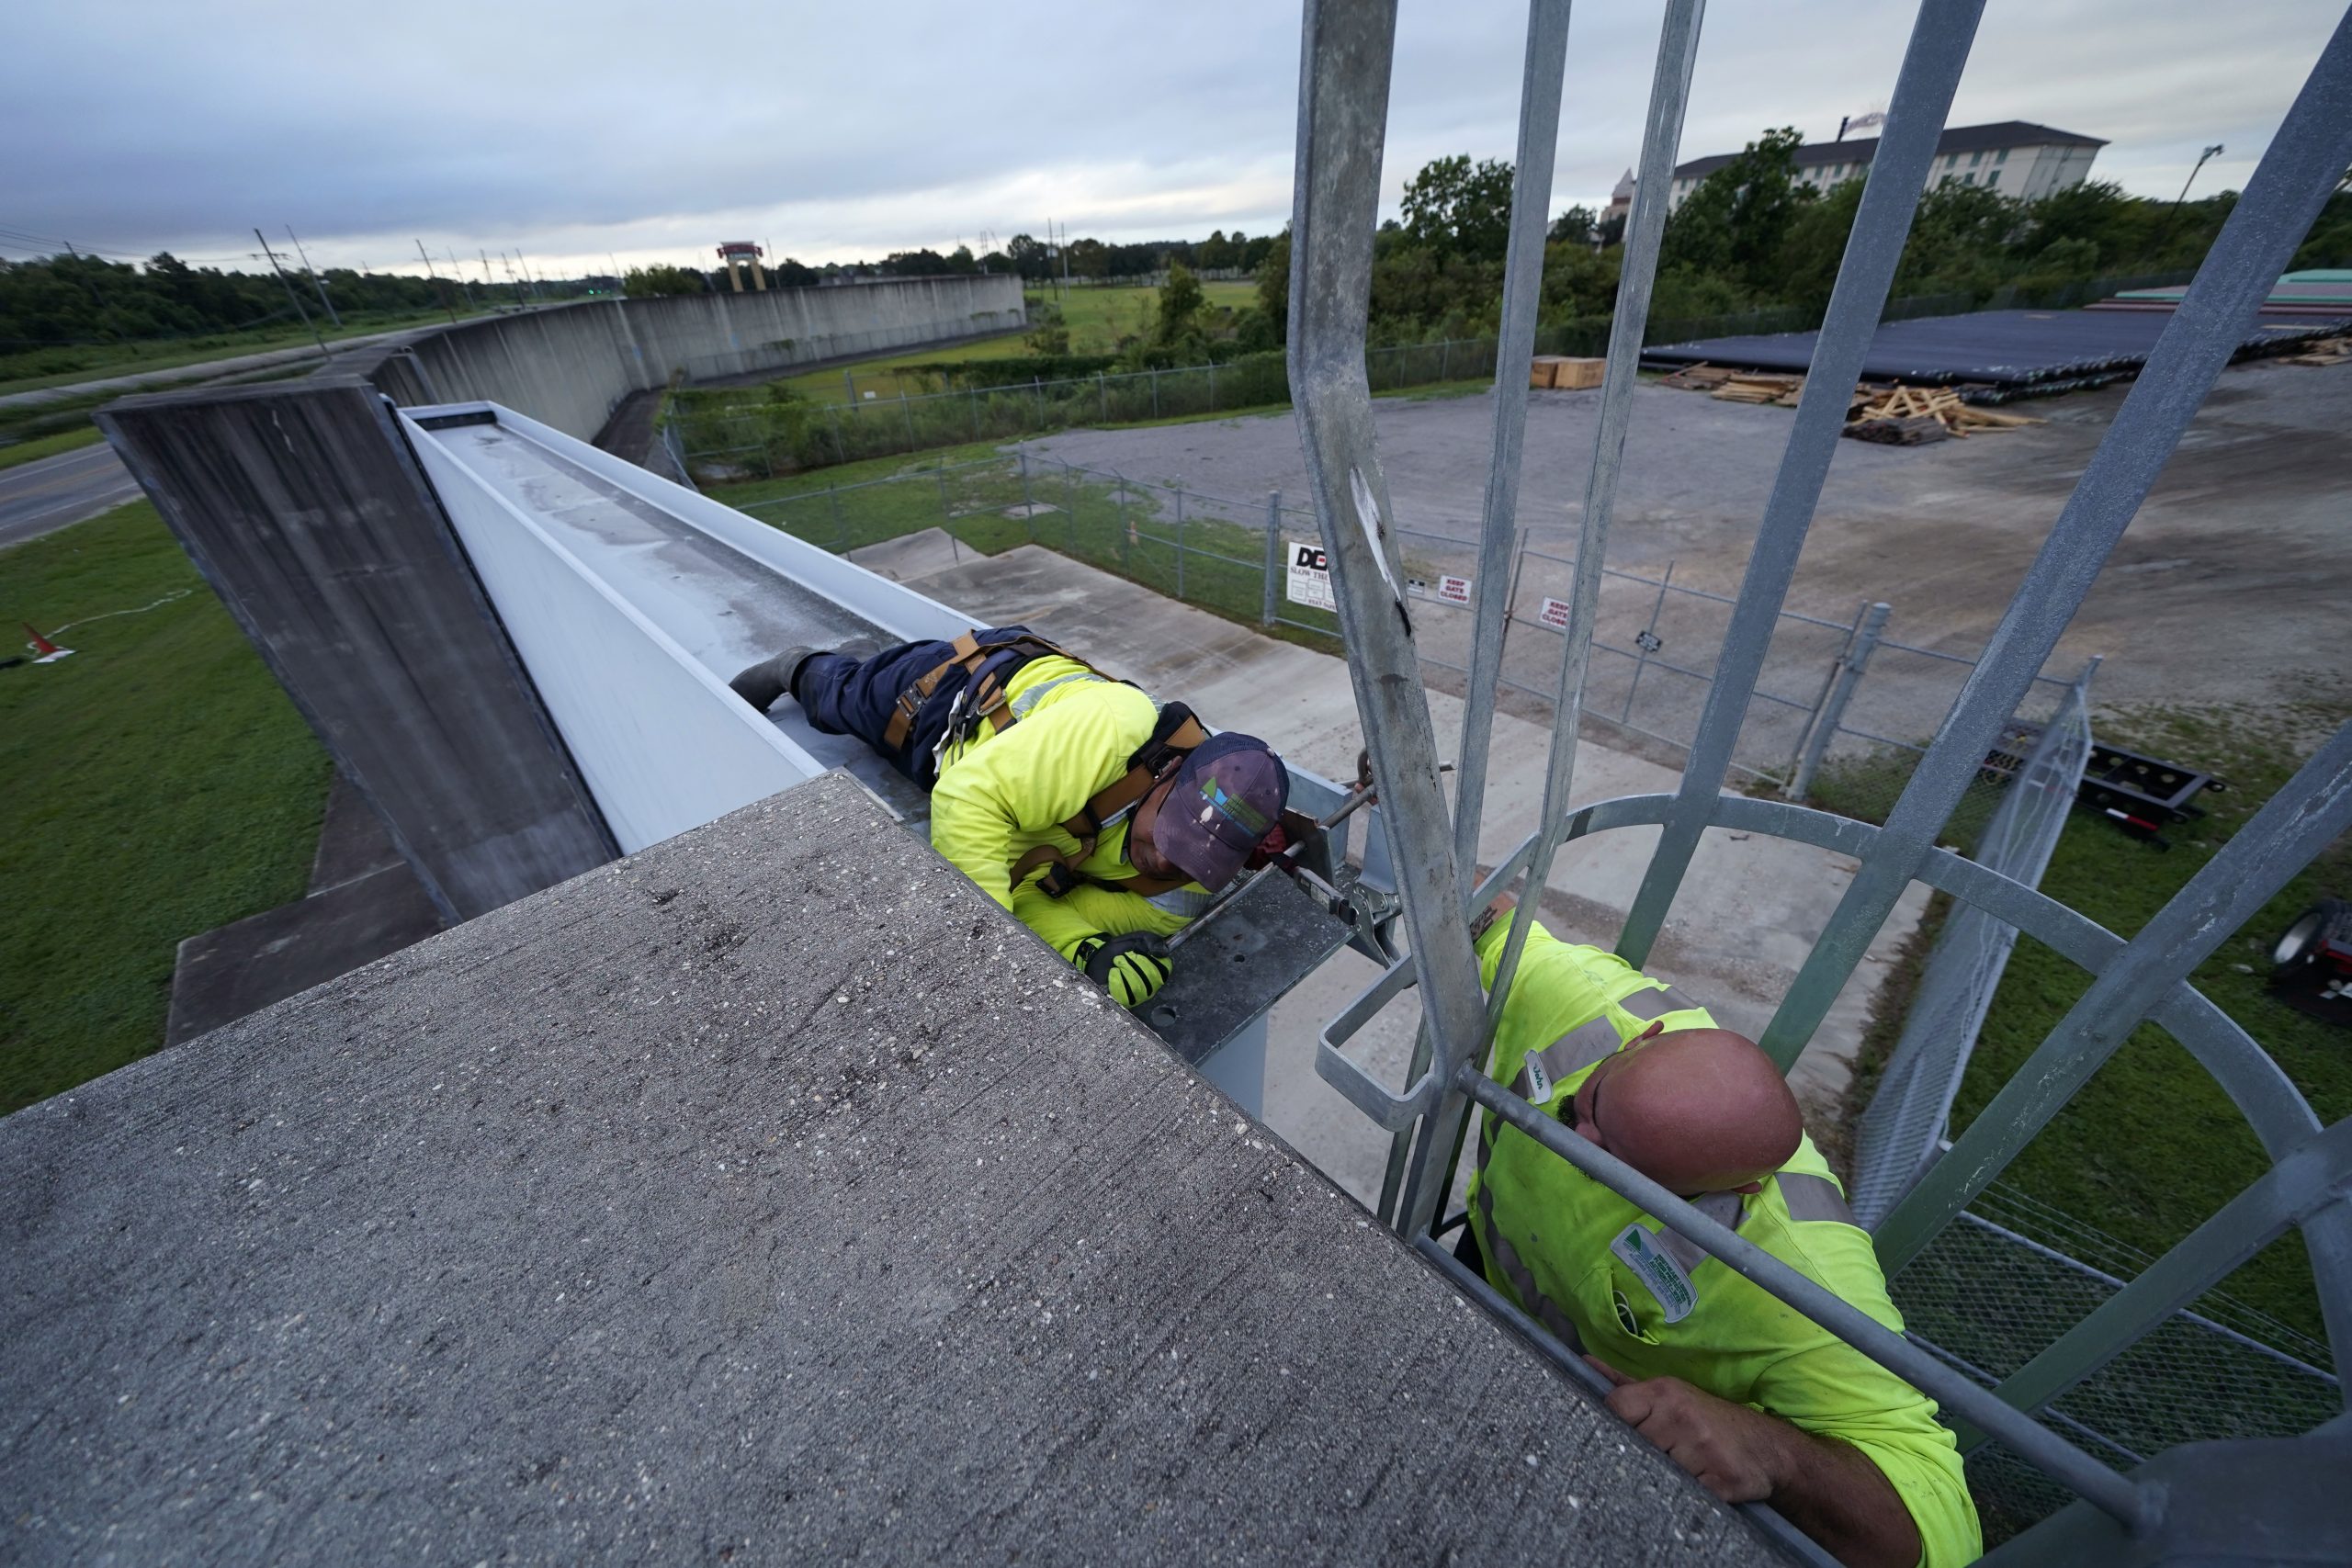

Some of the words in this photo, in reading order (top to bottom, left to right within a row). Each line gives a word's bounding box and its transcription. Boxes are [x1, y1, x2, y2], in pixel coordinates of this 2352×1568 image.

[1290, 566, 1310, 576] SLOW
[1445, 585, 1464, 593] GATE
[1440, 591, 1467, 601] CLOSED
[1533, 1066, 1544, 1090] John
